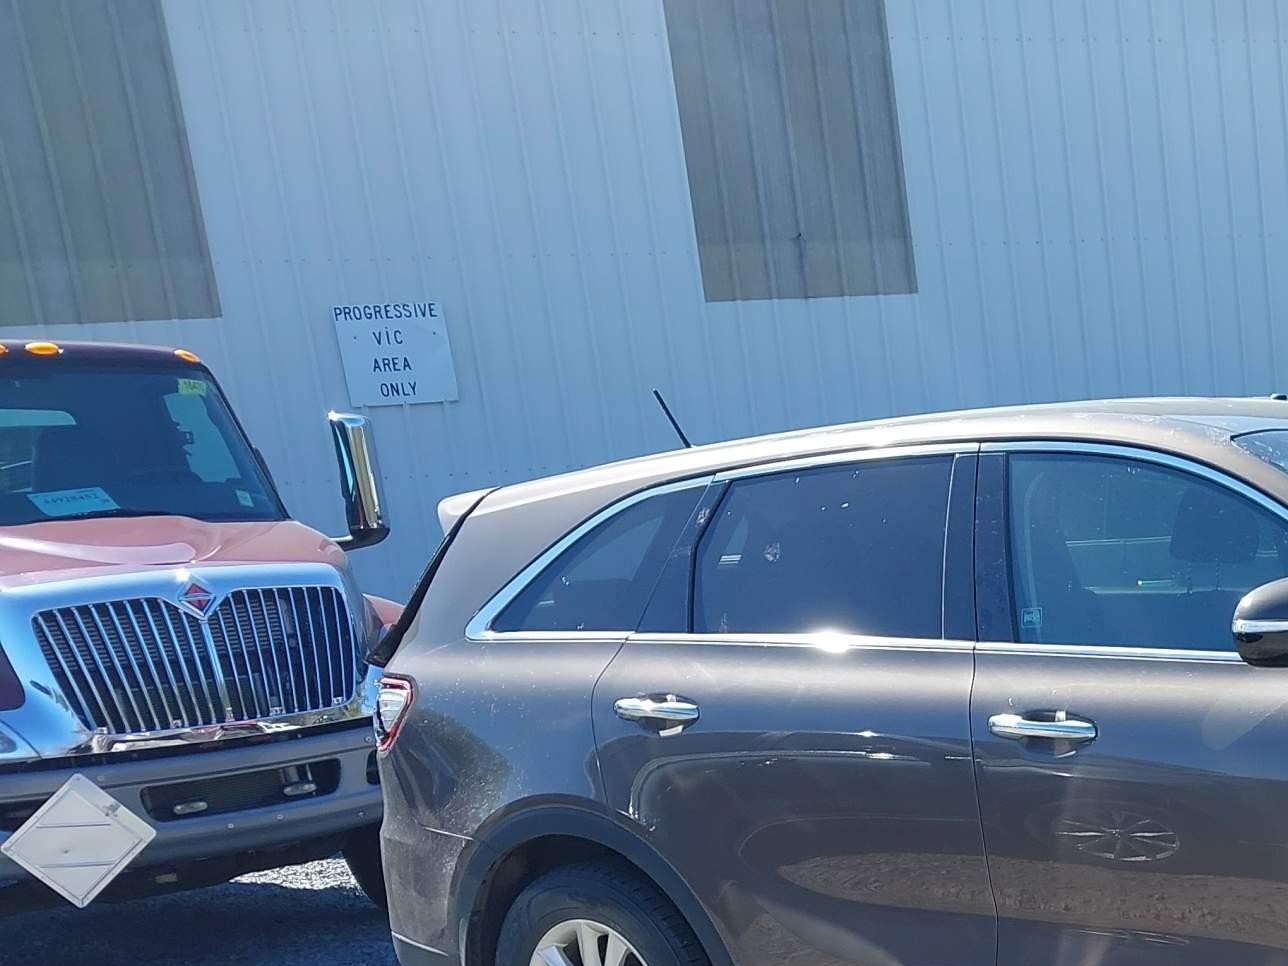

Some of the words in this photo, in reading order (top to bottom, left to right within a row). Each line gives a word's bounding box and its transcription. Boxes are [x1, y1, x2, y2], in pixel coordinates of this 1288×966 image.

[333, 302, 438, 321] PROGRESSIVE
[372, 330, 404, 346] VIC
[373, 356, 412, 373] AREA
[380, 381, 417, 397] ONLY
